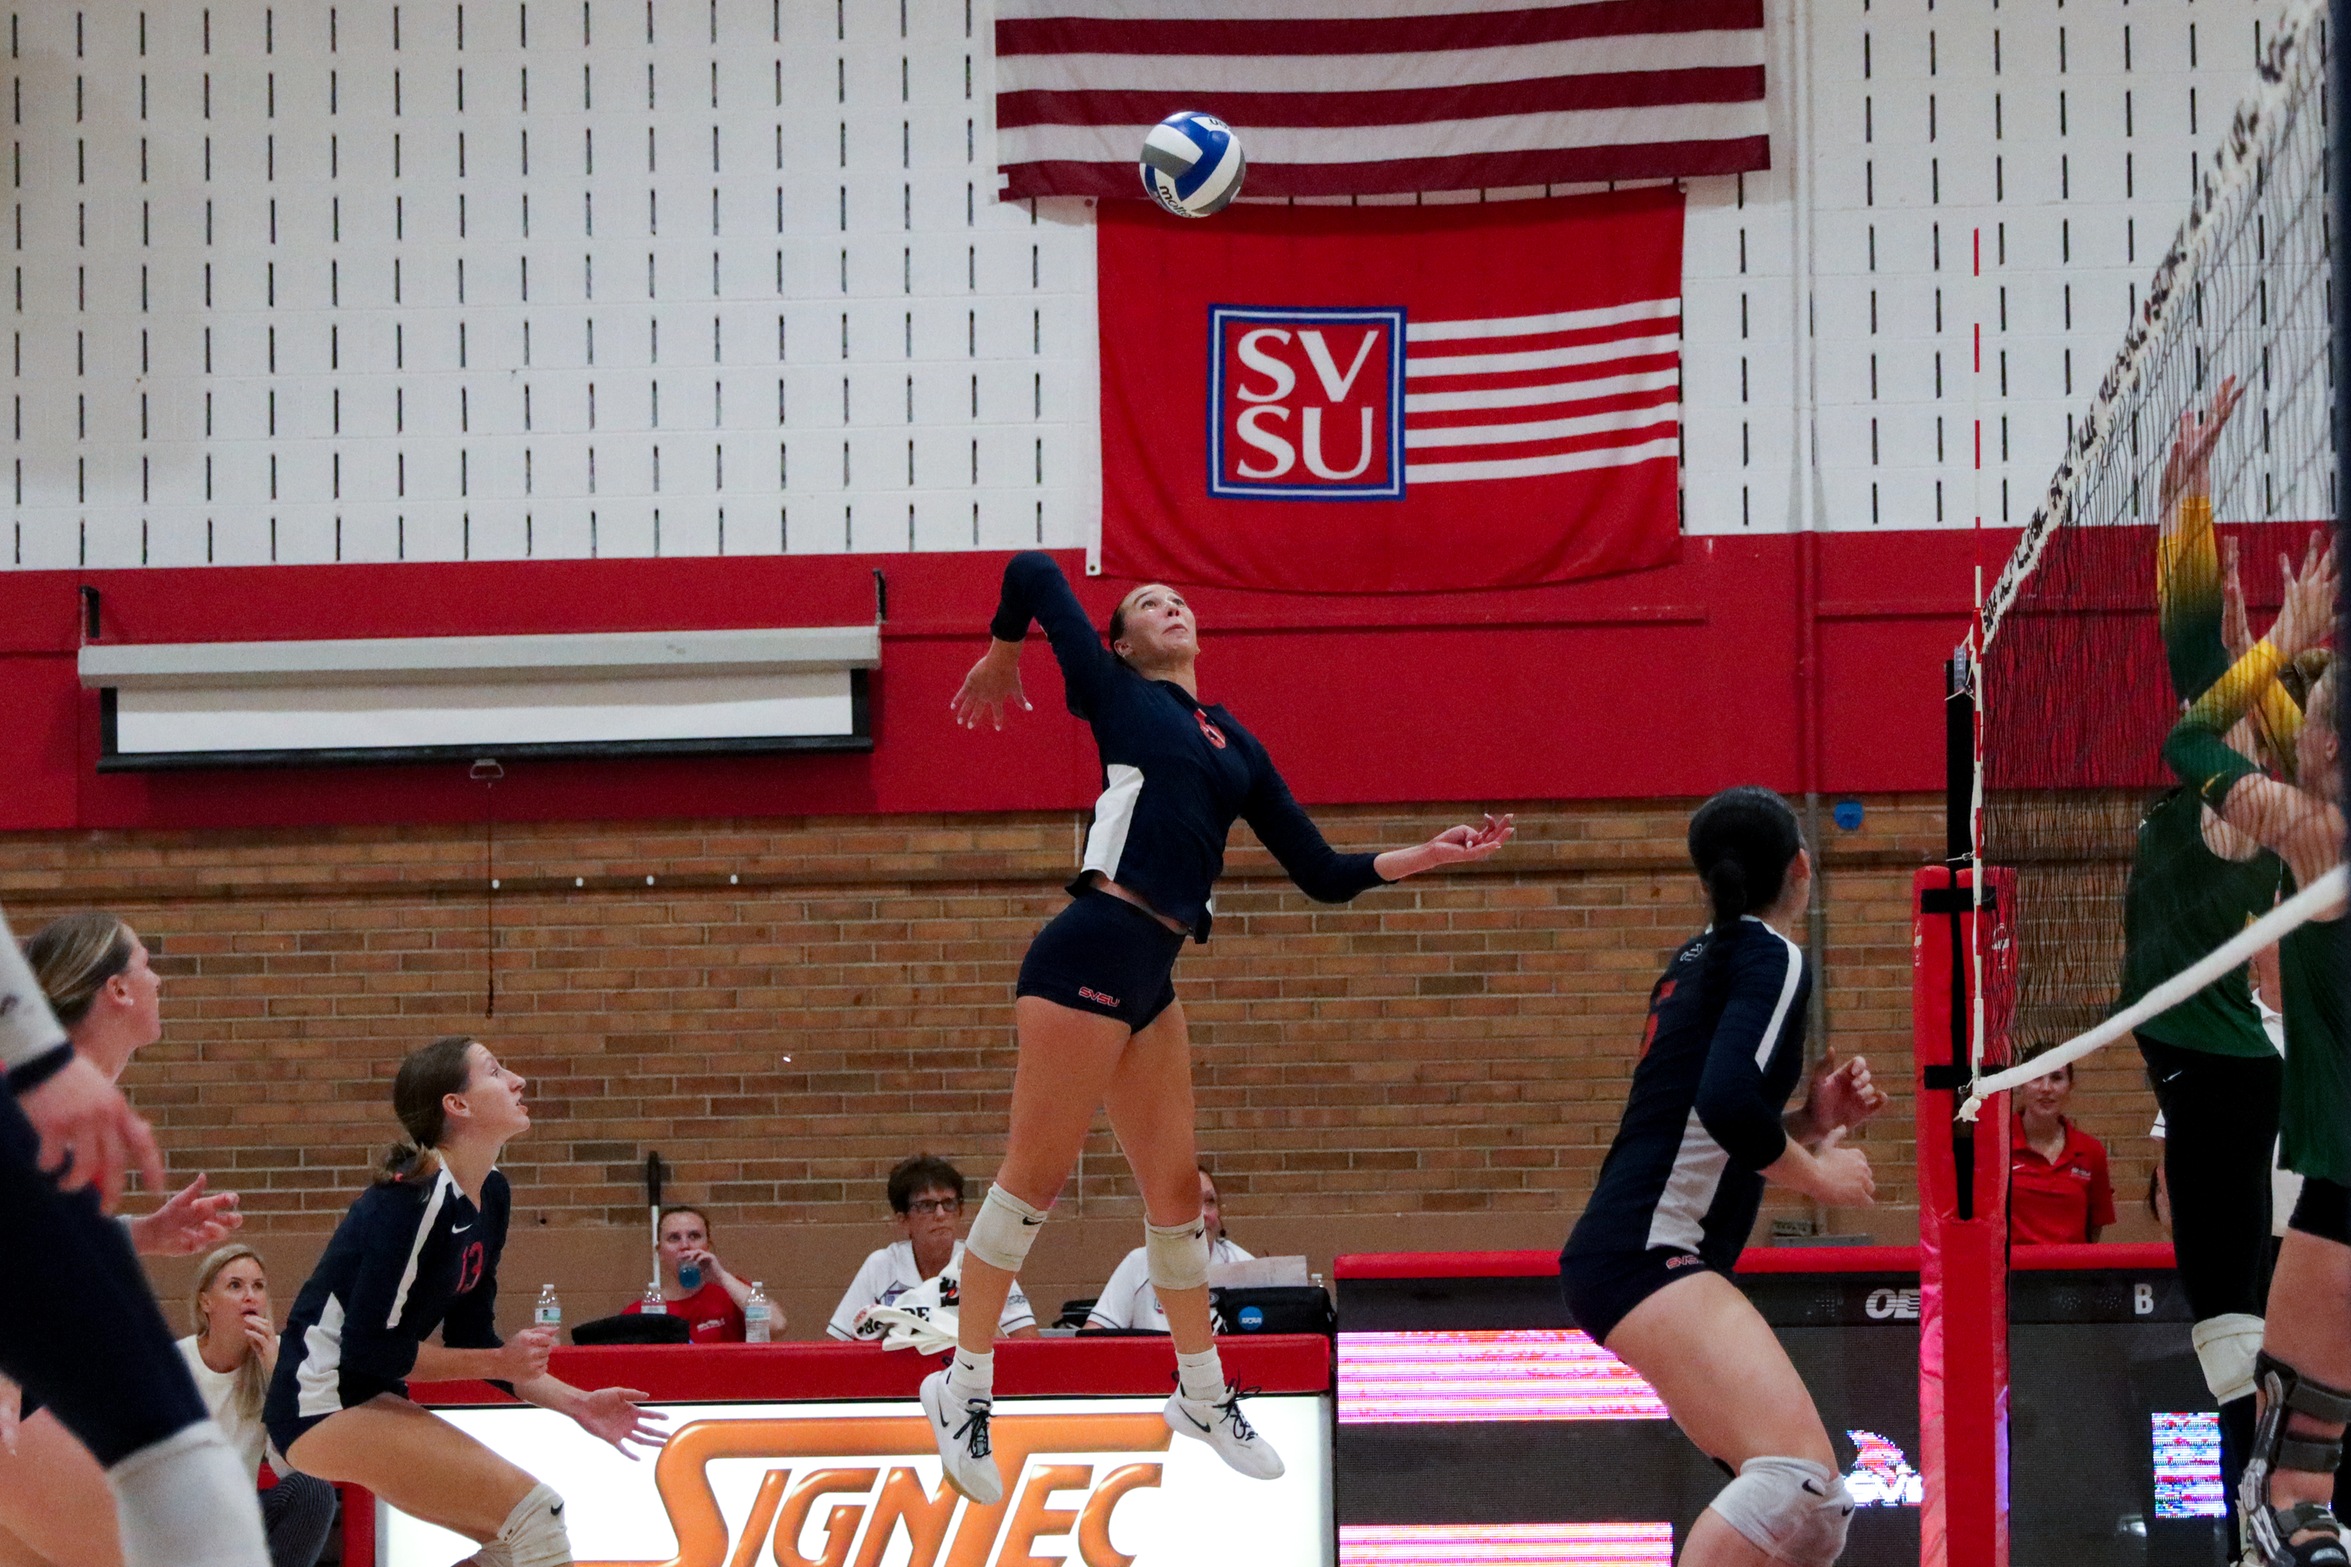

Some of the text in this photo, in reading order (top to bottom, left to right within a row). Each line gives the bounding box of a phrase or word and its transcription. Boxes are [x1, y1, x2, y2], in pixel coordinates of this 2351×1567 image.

[1236, 328, 1380, 403] SV
[1236, 404, 1374, 480] SU
[1078, 986, 1121, 1007] SVSU
[456, 1241, 484, 1294] 13
[1665, 1254, 1706, 1270] SVS
[1865, 1288, 1920, 1320] OE
[2134, 1283, 2154, 1315] B
[1843, 1470, 1923, 1508] SV
